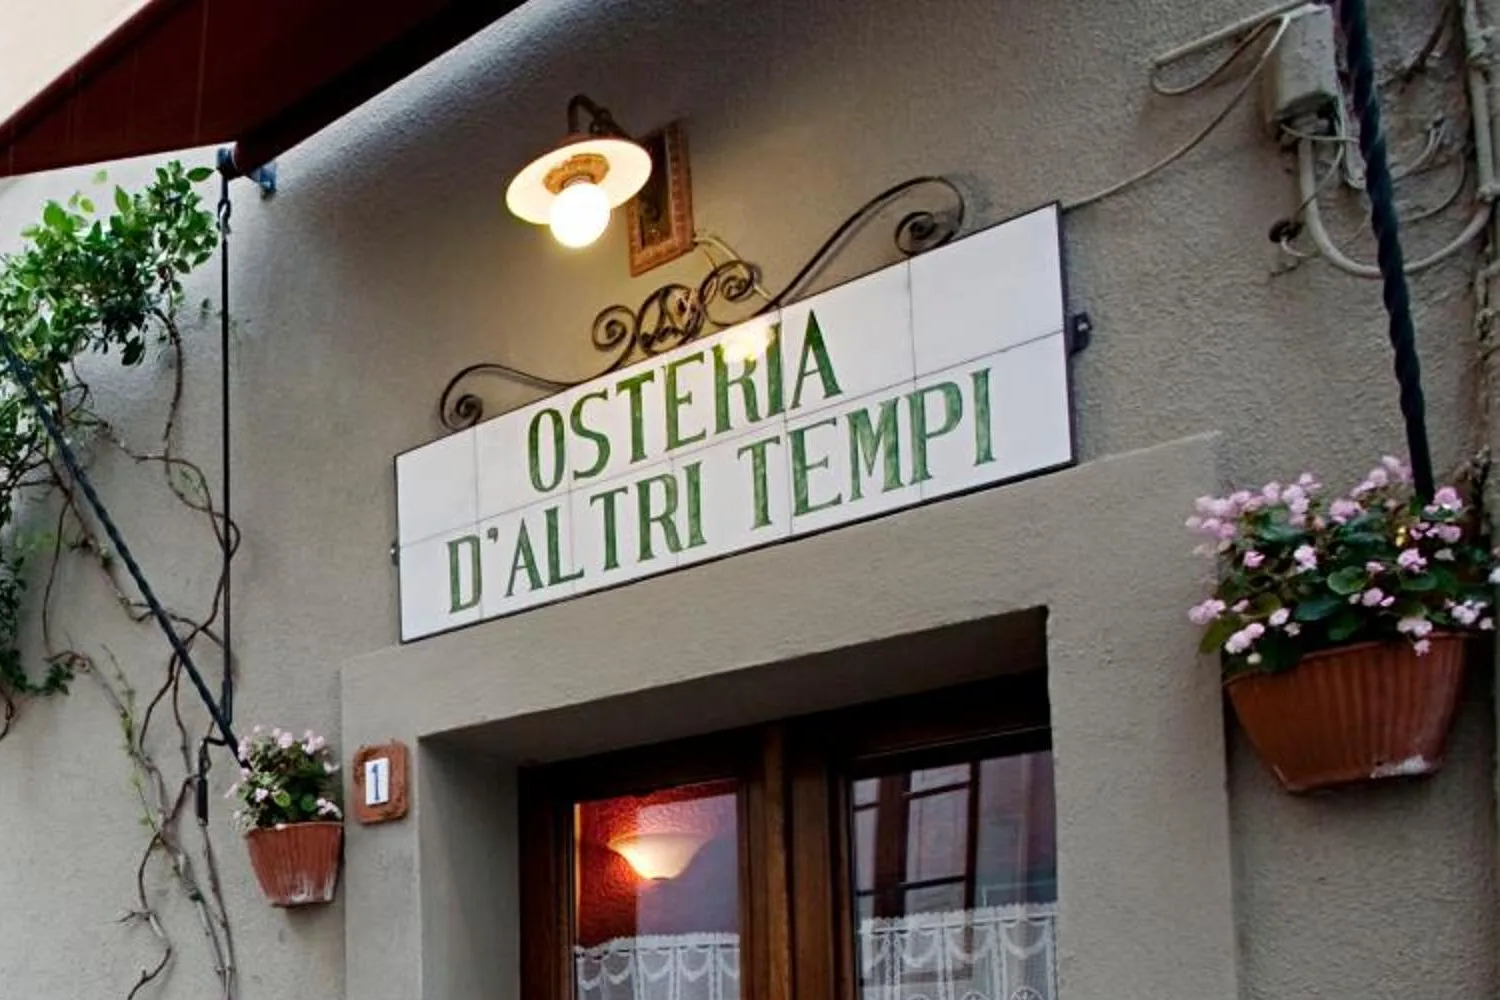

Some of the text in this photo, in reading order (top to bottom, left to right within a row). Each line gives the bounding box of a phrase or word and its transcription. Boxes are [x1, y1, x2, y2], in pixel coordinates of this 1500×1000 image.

[446, 367, 998, 614] D'ALTRI TEMPI
[527, 308, 843, 493] OSTERIA
